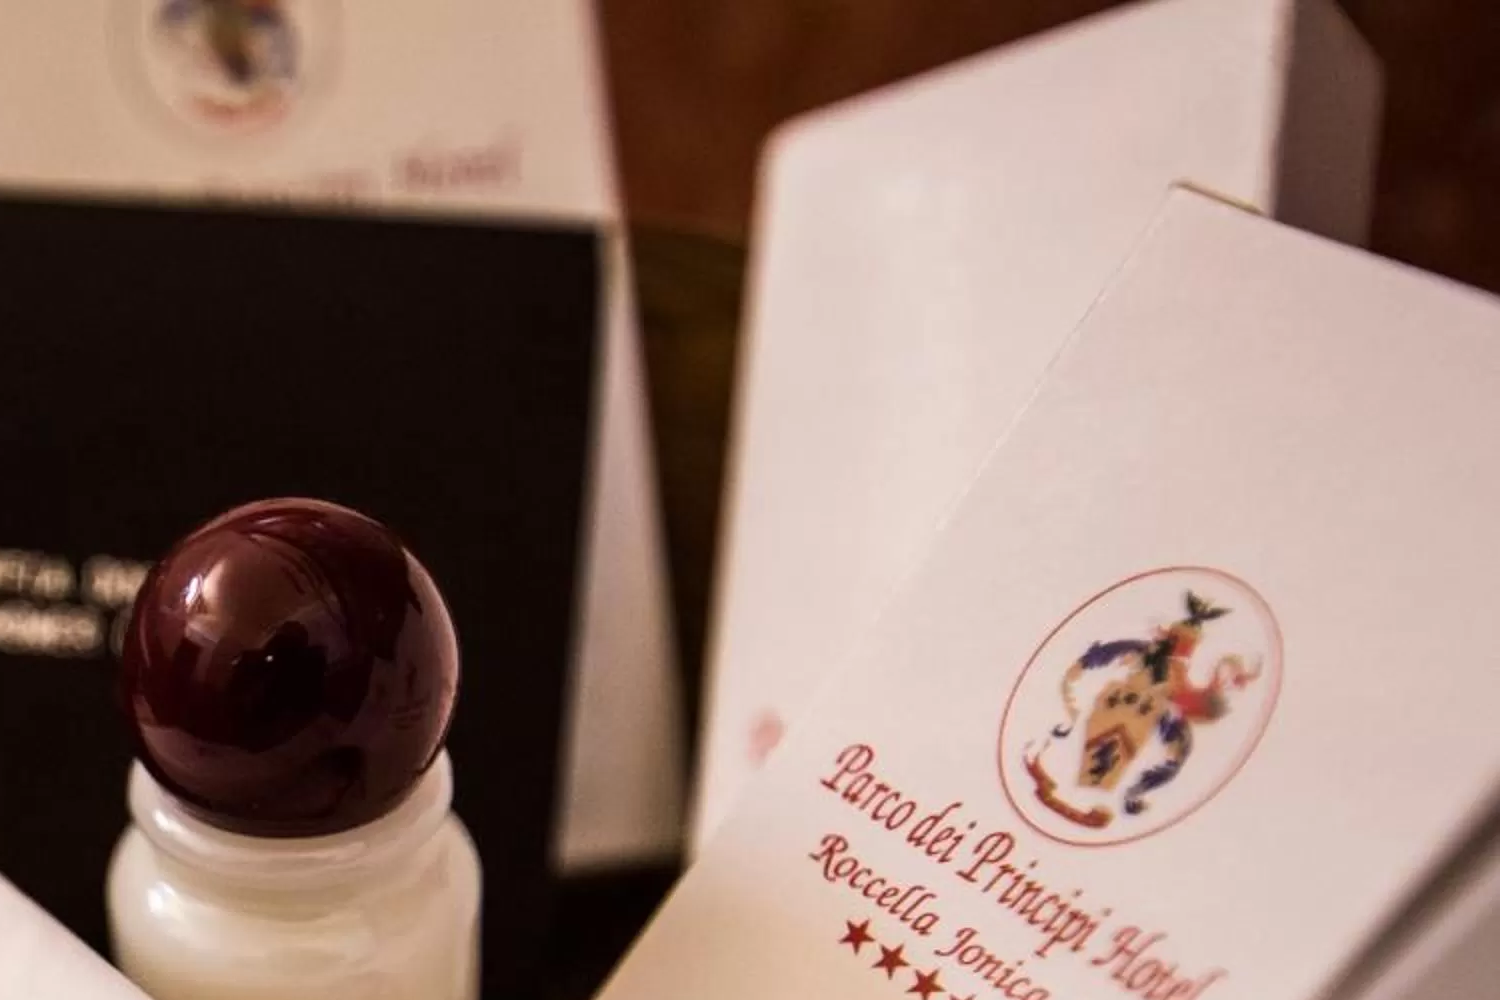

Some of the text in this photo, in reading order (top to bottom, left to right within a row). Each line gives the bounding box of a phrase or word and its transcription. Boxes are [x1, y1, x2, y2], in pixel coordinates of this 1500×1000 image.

[808, 833, 940, 936] Roccella
[820, 744, 917, 831] Parco
[906, 801, 977, 864] dei
[956, 831, 1113, 958] Principi
